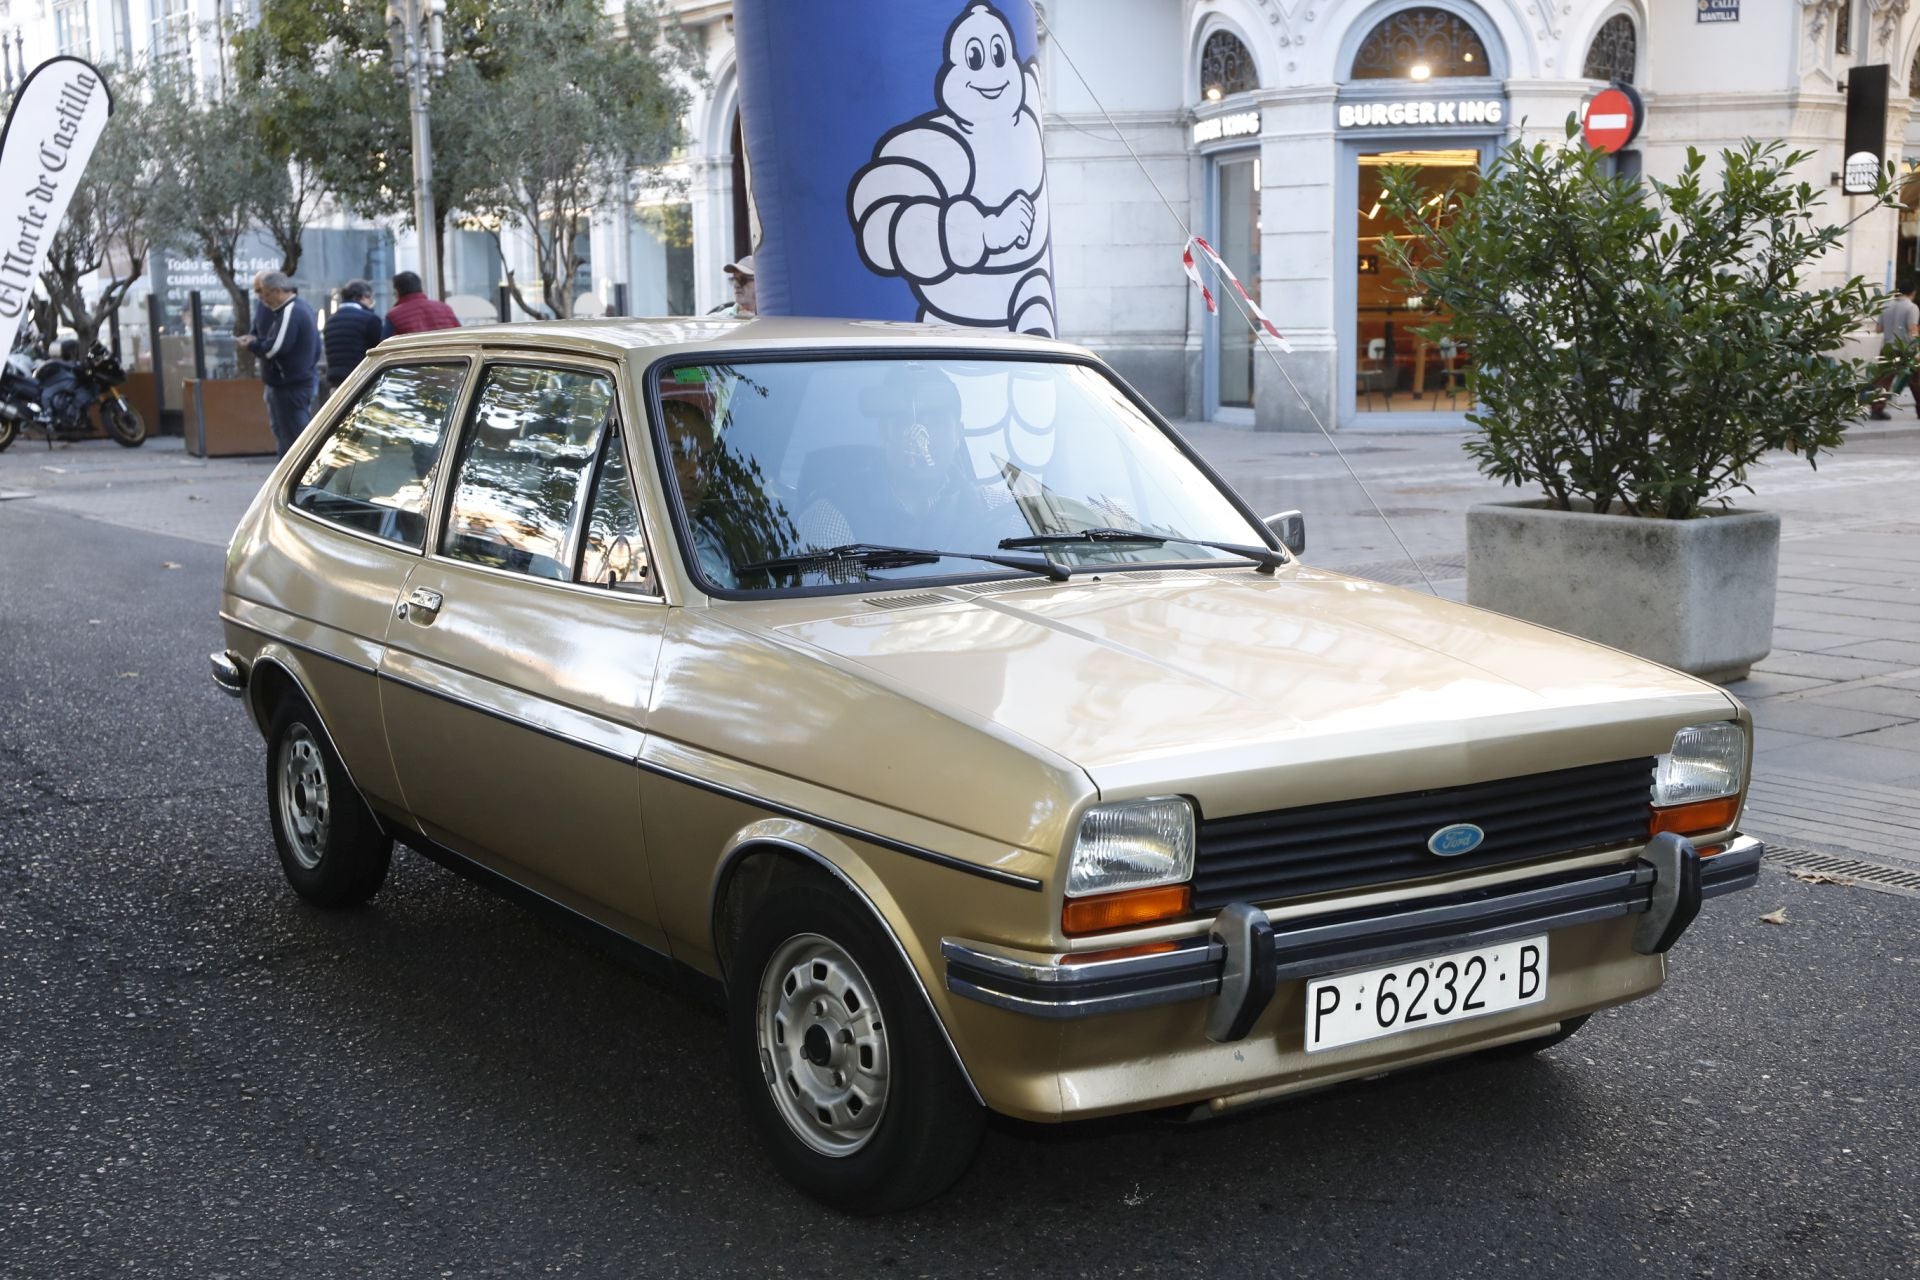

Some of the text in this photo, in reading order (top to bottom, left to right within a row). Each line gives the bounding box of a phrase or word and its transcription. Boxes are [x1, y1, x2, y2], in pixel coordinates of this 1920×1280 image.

[39, 73, 97, 172] Castilla
[1222, 112, 1259, 136] KING
[1339, 101, 1502, 127] BURGER KING
[26, 174, 58, 203] de
[2, 205, 47, 277] Norte
[166, 257, 199, 271] Todo
[250, 257, 280, 271] fácil
[166, 273, 217, 286] cuando
[168, 288, 181, 300] el
[1442, 830, 1473, 849] Ford
